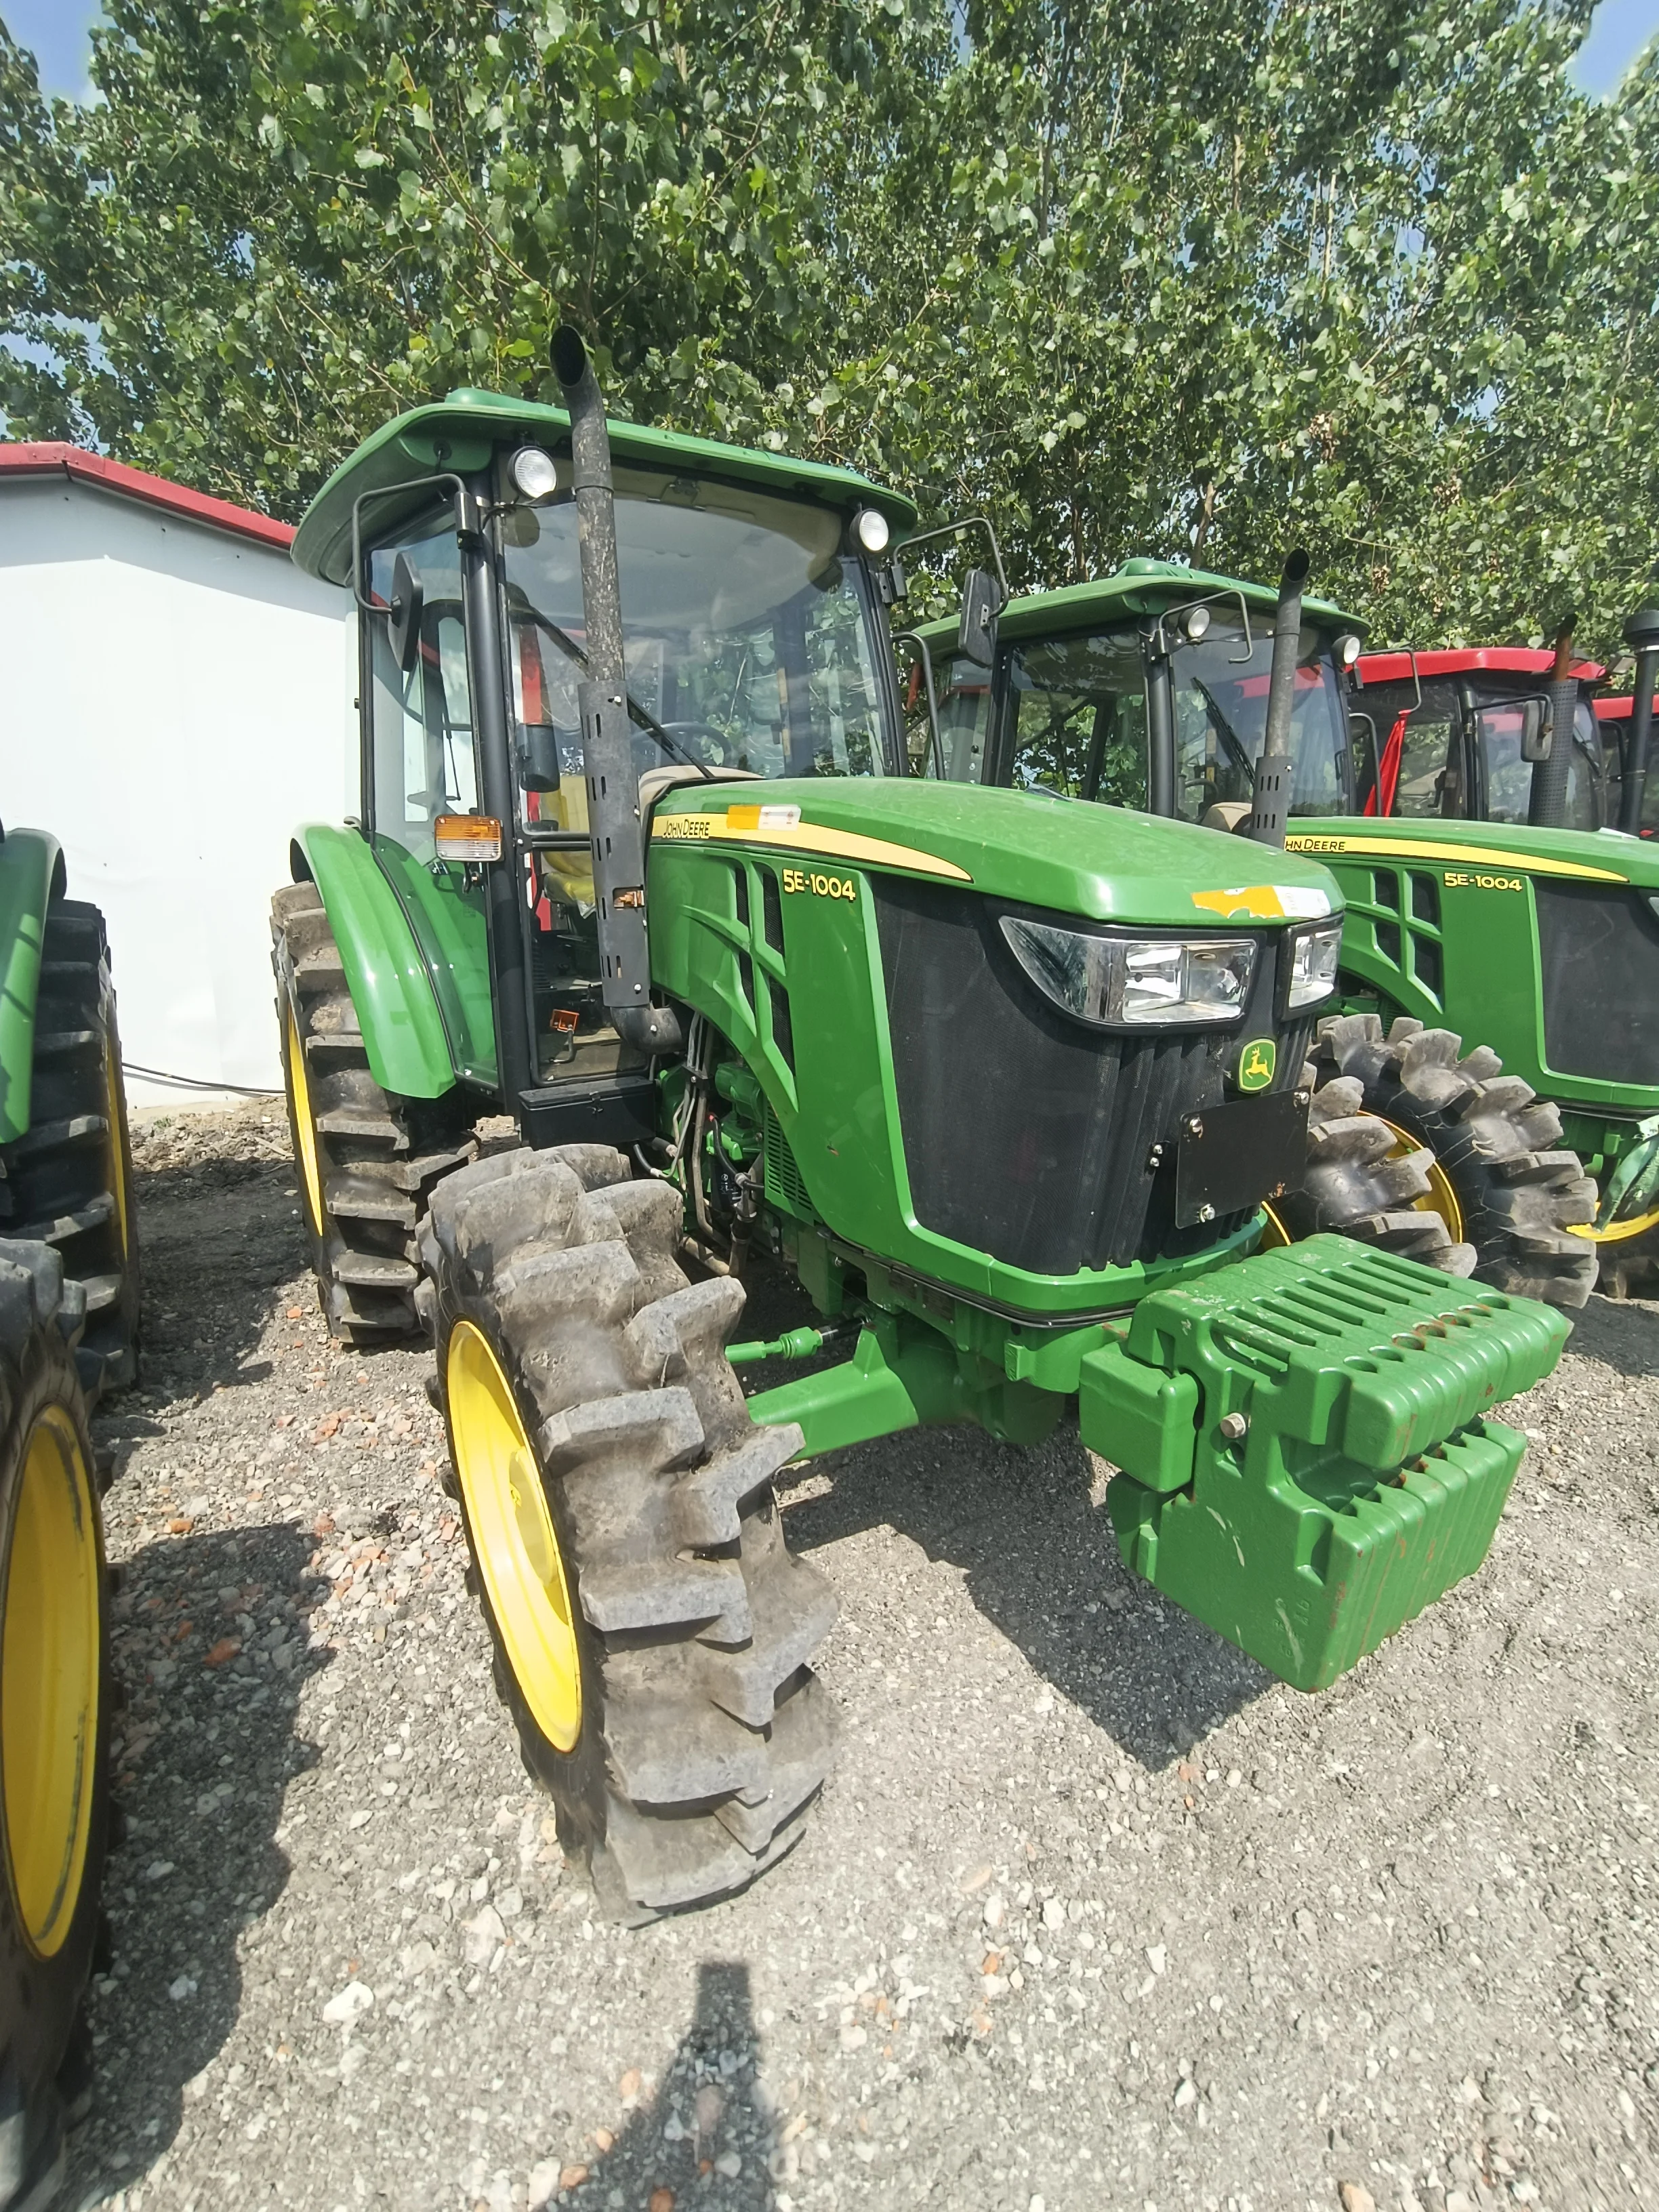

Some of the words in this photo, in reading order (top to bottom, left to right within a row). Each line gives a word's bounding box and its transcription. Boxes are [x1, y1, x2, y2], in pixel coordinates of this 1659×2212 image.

[663, 820, 683, 836] JOHN
[683, 819, 710, 836] DEERE
[1303, 838, 1346, 851] DEERE
[783, 869, 856, 901] 5E-1004
[1444, 872, 1523, 891] 5E-1004
